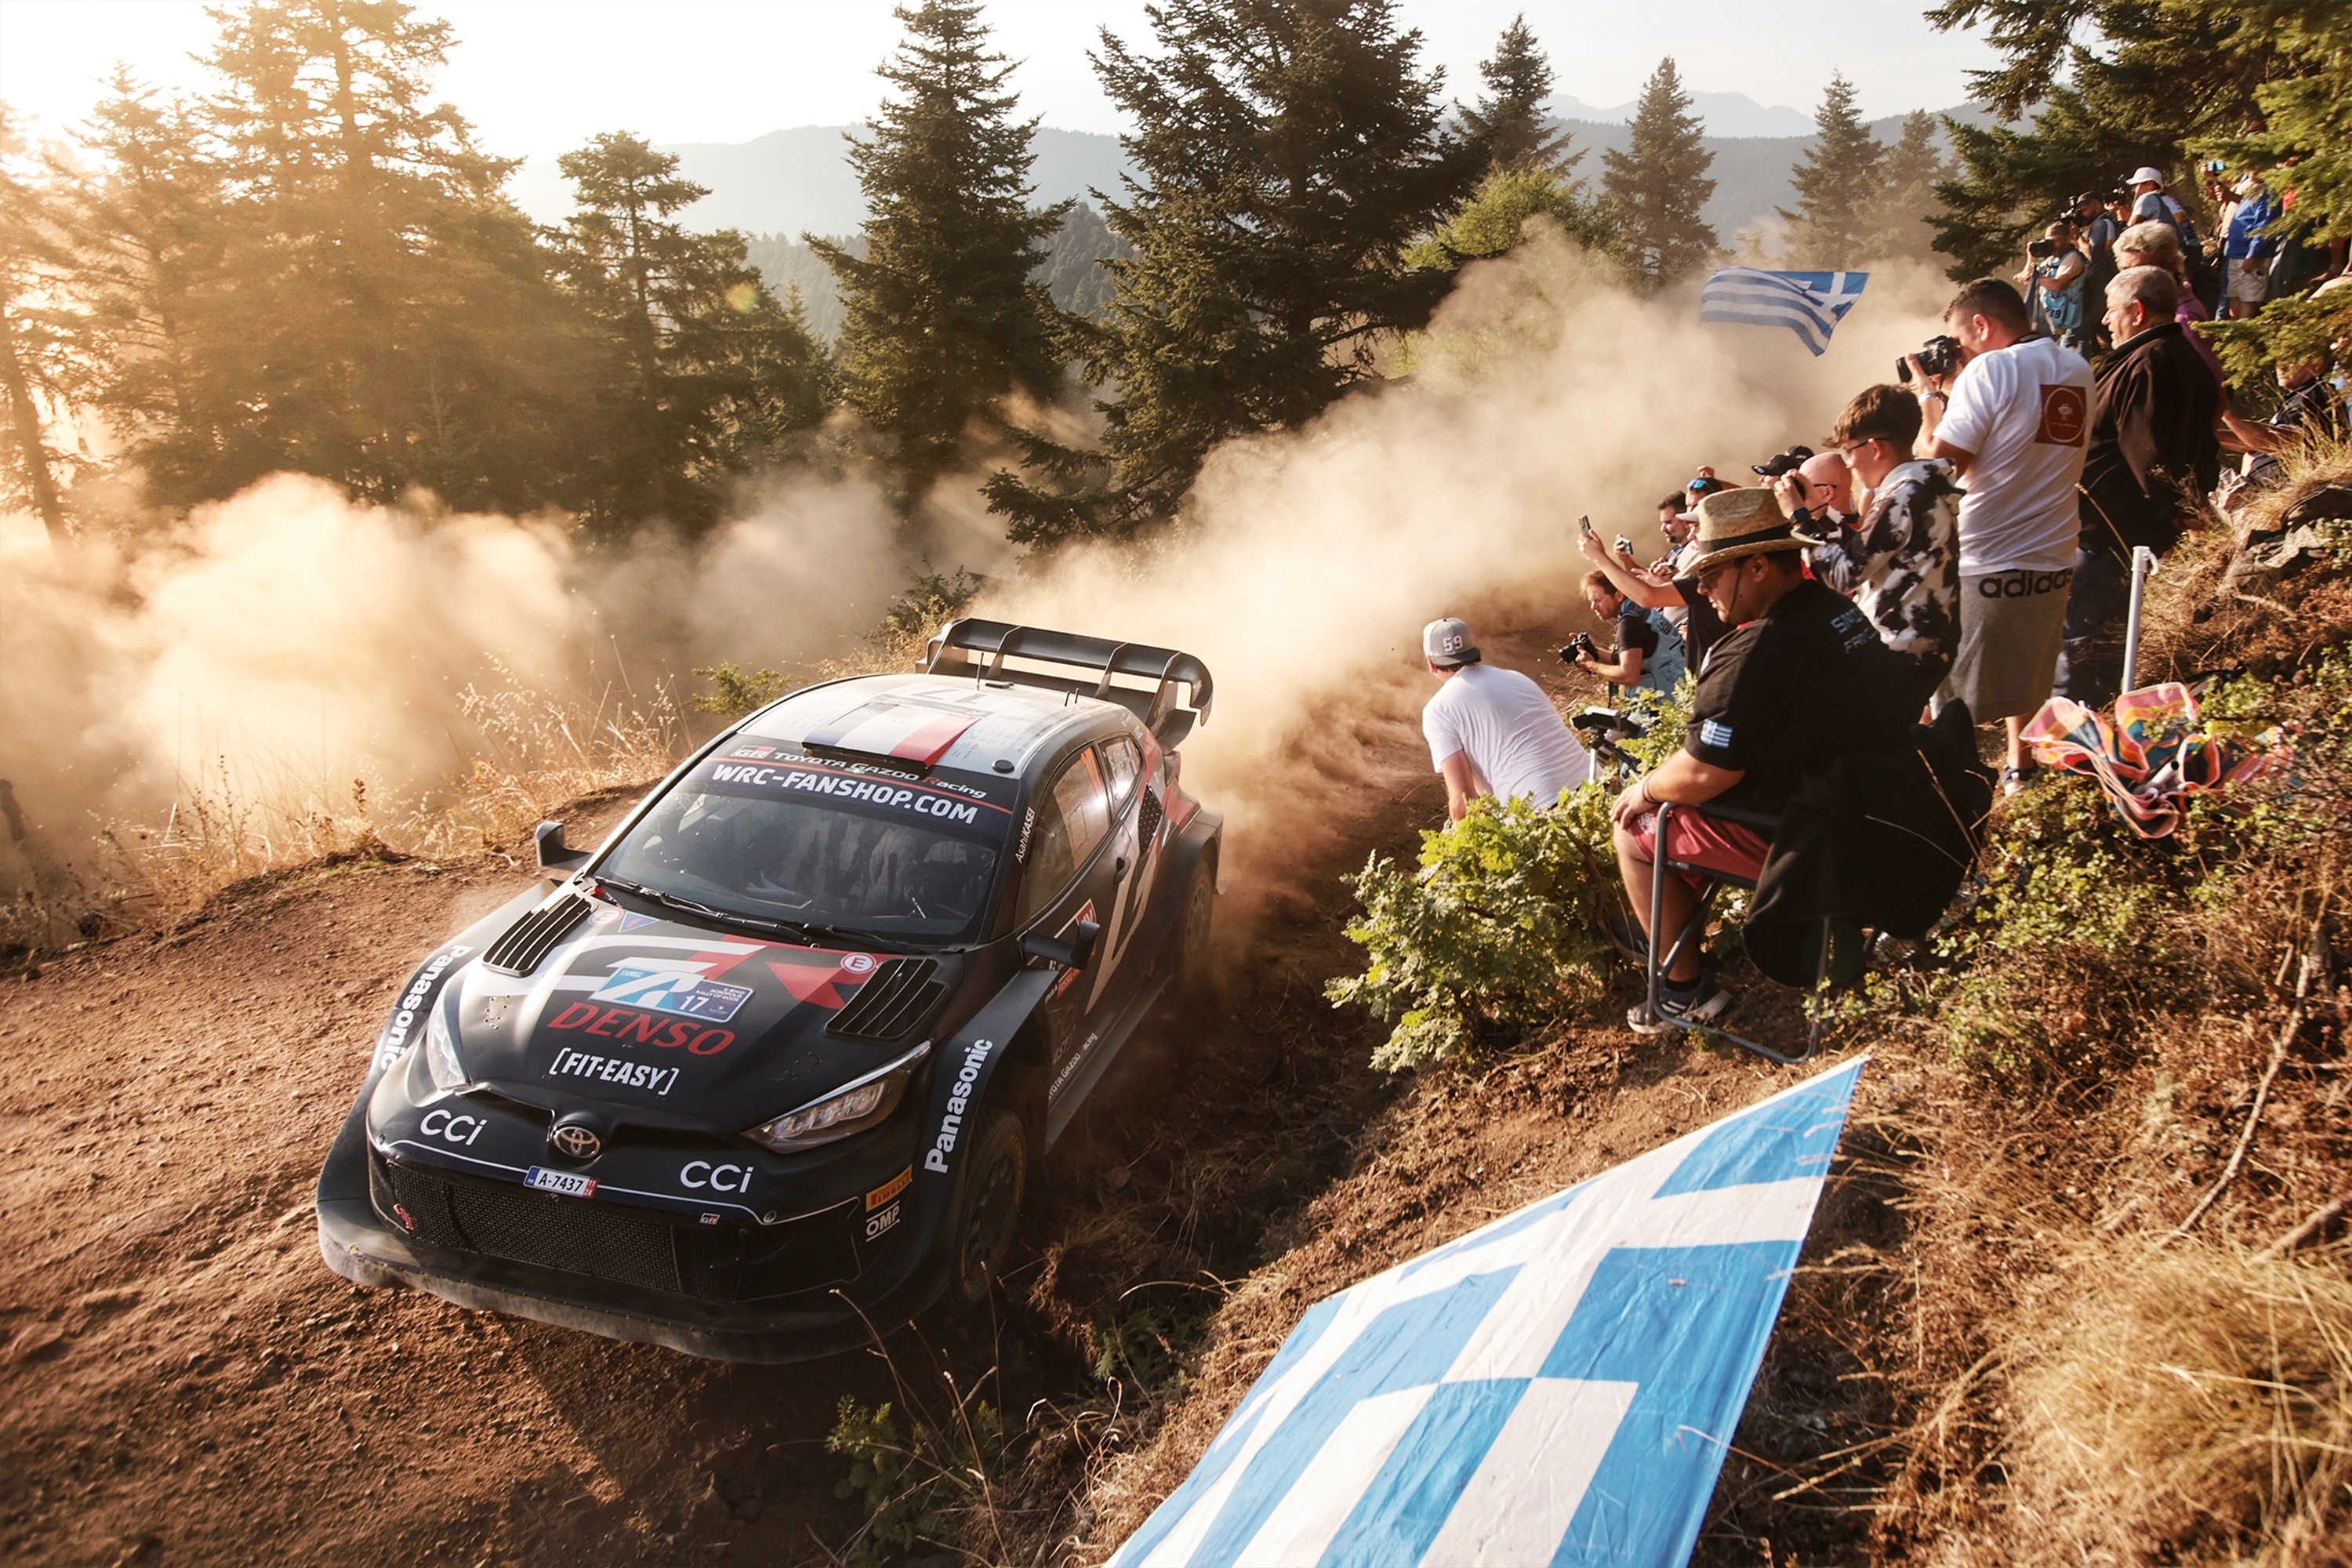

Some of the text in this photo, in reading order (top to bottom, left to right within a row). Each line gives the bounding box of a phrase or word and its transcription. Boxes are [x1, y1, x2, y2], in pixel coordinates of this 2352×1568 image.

[1443, 635, 1463, 652] 59
[774, 752, 987, 799] TOYOTA GAZOO Racing
[712, 764, 979, 825] WRC-FANSHOP.COM
[851, 957, 866, 969] E
[380, 945, 474, 1070] Panasonic
[679, 995, 710, 1012] 17
[547, 1002, 736, 1056] DENSO
[1048, 1076, 1065, 1100] YOTA
[924, 1039, 993, 1174] Panasonic
[538, 1173, 584, 1192] A-7437
[871, 1169, 911, 1207] PIRELLI
[866, 1204, 900, 1237] OMP
